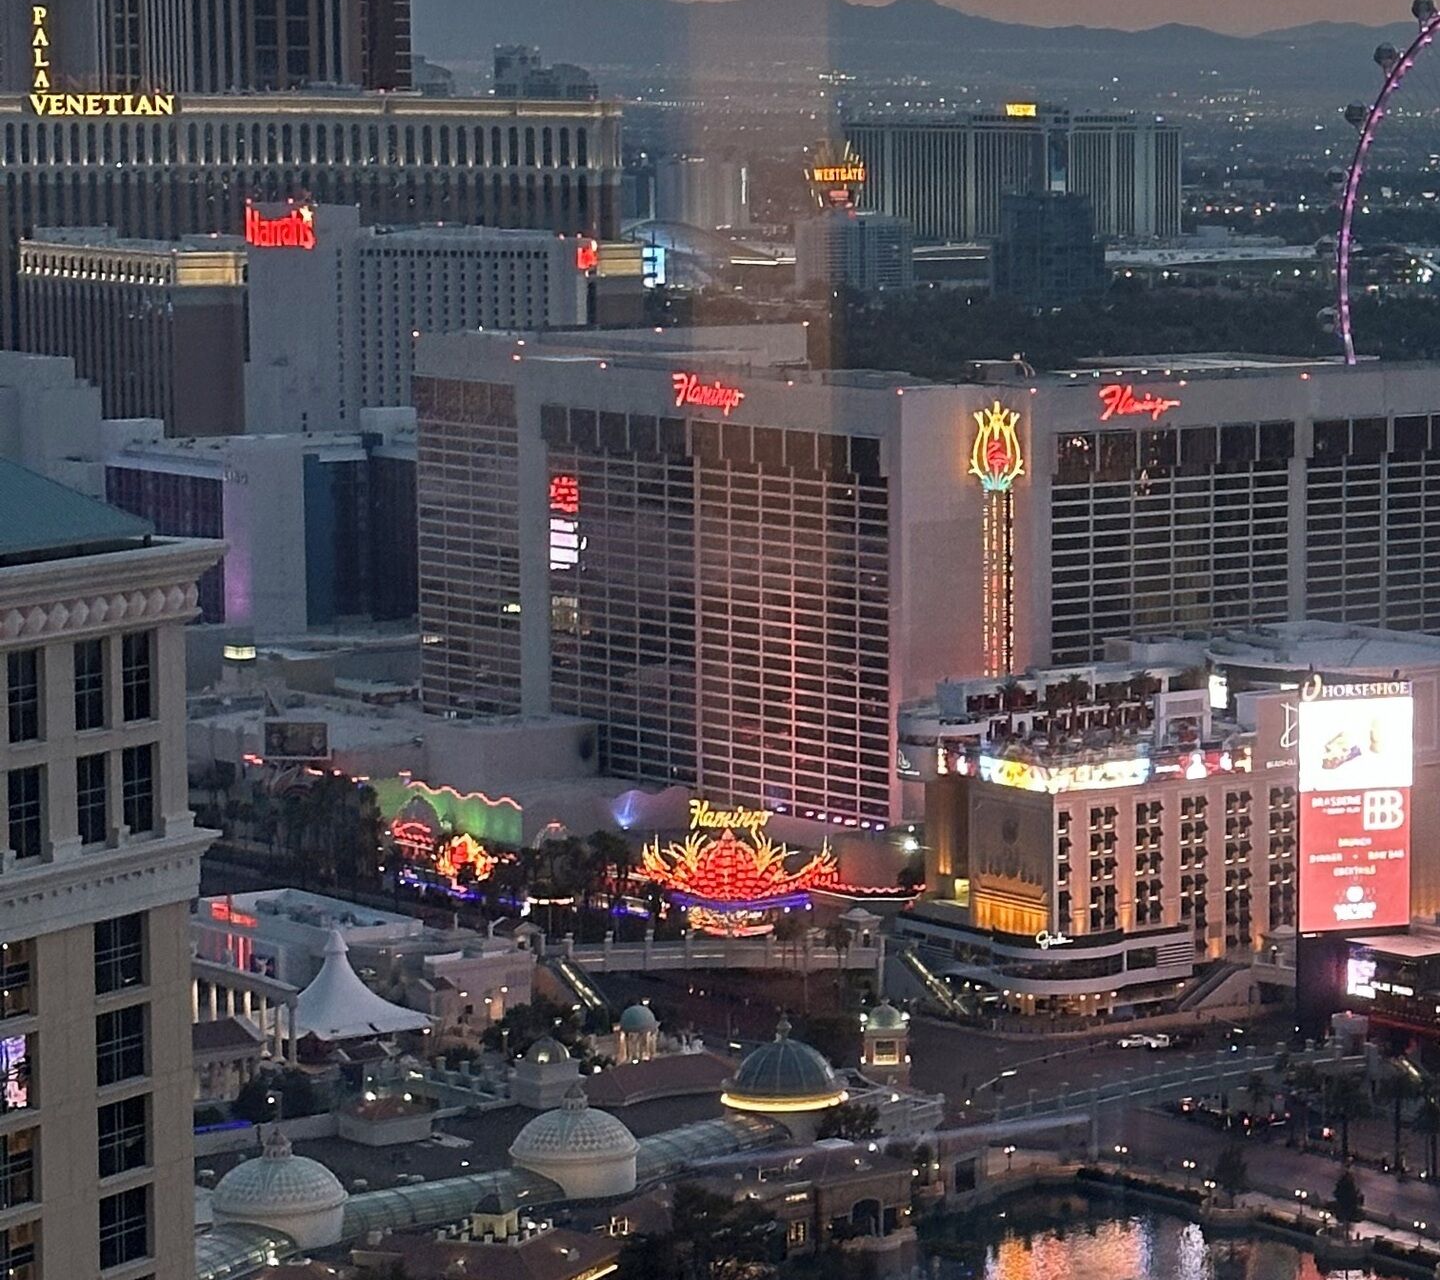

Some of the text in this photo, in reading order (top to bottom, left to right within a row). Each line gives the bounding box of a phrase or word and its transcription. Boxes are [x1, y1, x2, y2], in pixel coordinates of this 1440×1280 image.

[32, 6, 50, 93] PALA
[29, 94, 175, 116] VENETIAN
[672, 372, 745, 417] Flamingo
[1321, 680, 1413, 698] HORSESHOE
[688, 799, 774, 844] Flamingo
